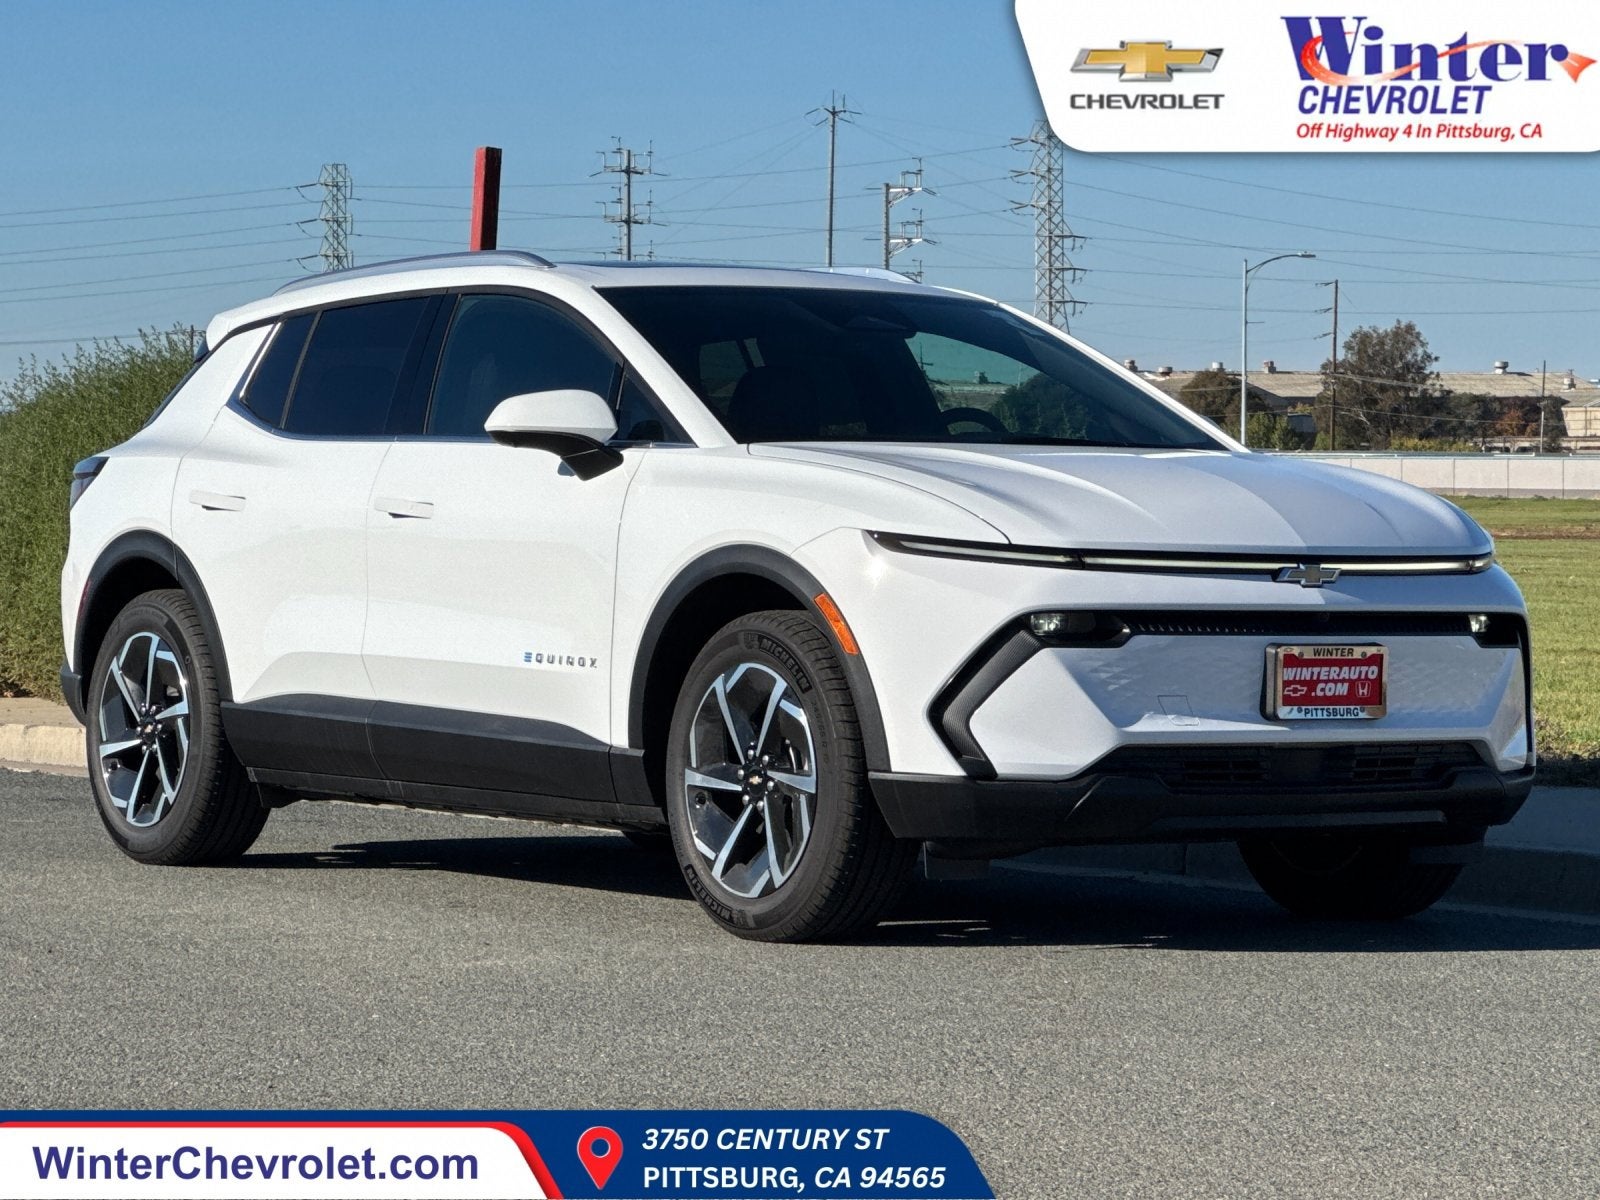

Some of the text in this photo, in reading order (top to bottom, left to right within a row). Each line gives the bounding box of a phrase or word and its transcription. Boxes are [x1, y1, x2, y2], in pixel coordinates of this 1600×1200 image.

[1313, 647, 1354, 657] WINTER
[524, 652, 597, 668] EQUINOX
[759, 637, 812, 692] MICHELIN
[1283, 665, 1378, 680] WINTERAUTO
[1311, 682, 1349, 697] .COM
[1304, 707, 1359, 717] PITTSBURG
[685, 865, 732, 921] MICHELIN
